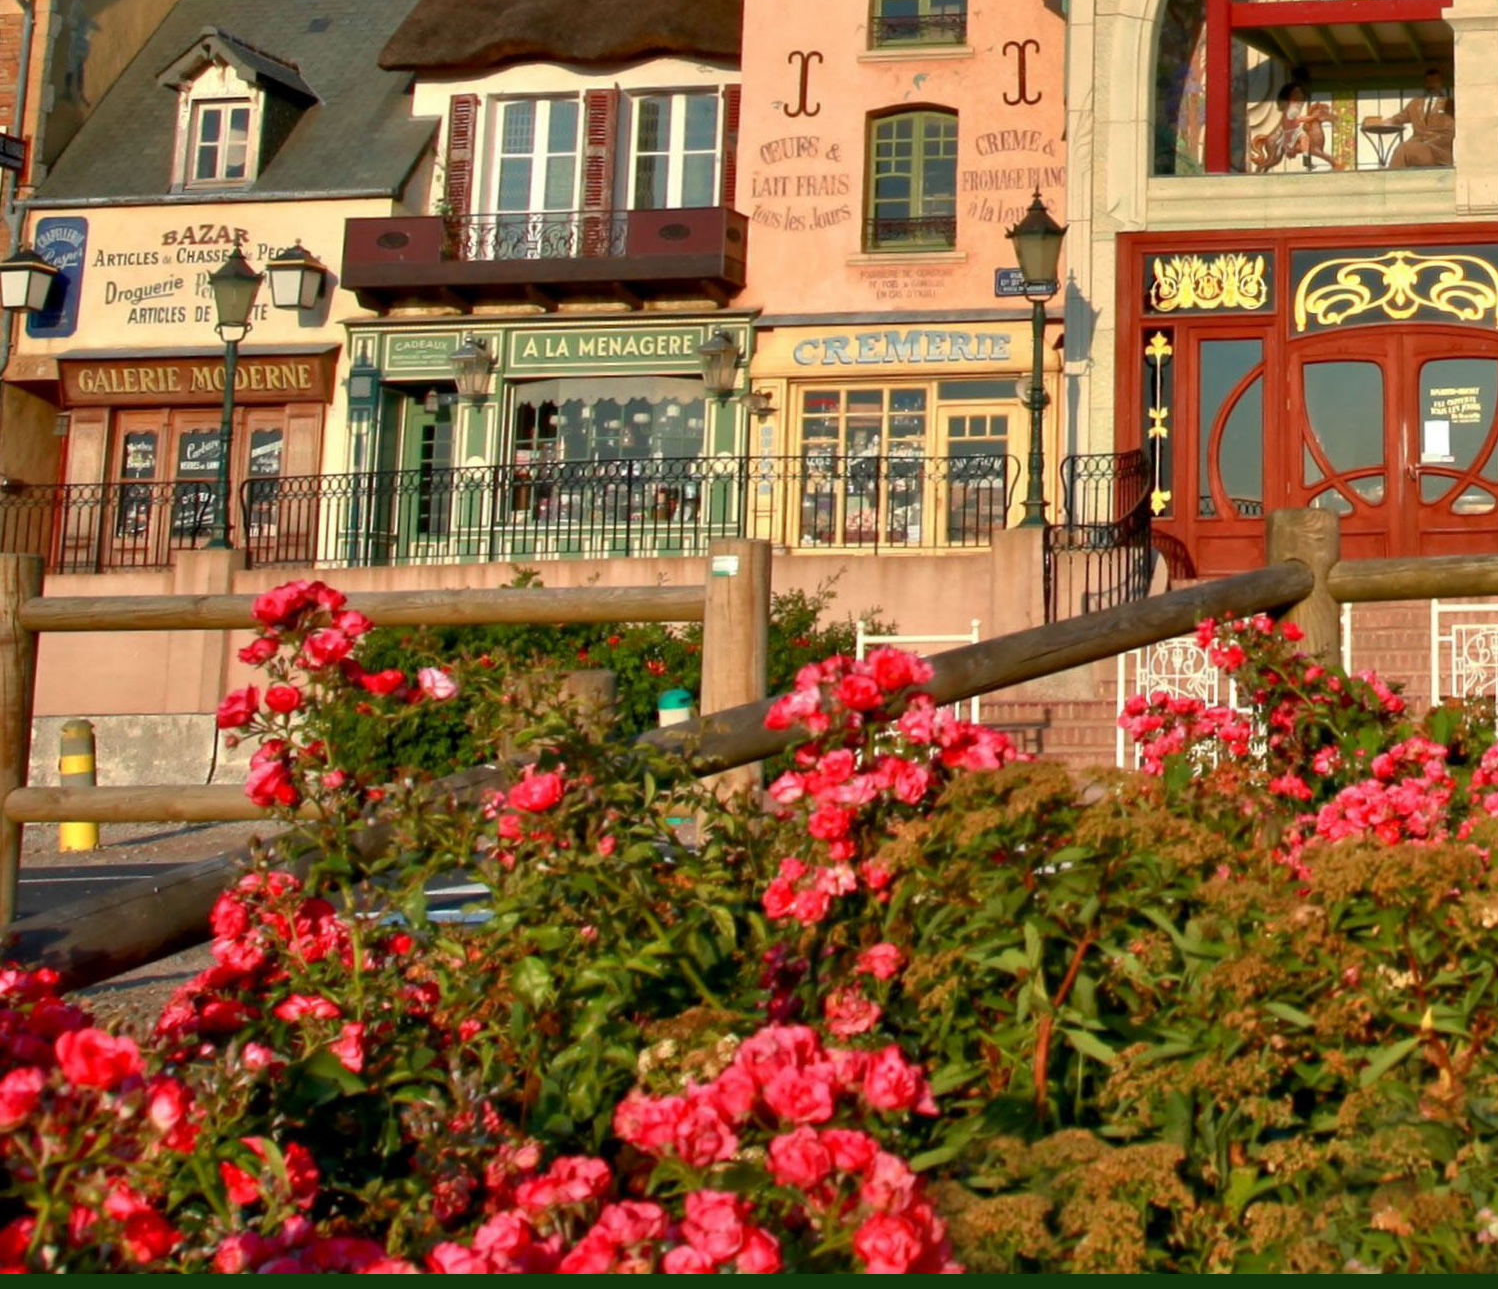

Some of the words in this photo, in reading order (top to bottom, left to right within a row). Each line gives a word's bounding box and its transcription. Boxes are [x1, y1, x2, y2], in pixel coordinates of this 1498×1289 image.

[826, 143, 841, 162] &
[751, 176, 789, 198] LAIT
[796, 174, 850, 197] FRAIS
[963, 168, 1024, 191] FROMAGE
[785, 206, 805, 231] les
[161, 224, 250, 246] BAZAR
[93, 248, 159, 267] ARTICLES
[176, 247, 229, 264] CHASSE
[105, 274, 185, 306] Droguerie
[127, 306, 186, 325] ARTICLES
[195, 306, 211, 323] DE
[394, 340, 449, 352] CADEAUX
[522, 337, 539, 358] A
[545, 337, 570, 358] LA
[578, 333, 694, 358] MENAGERE
[793, 329, 1012, 366] CREMERIE
[78, 365, 182, 394] GALERIE
[190, 363, 312, 393] MODERNE
